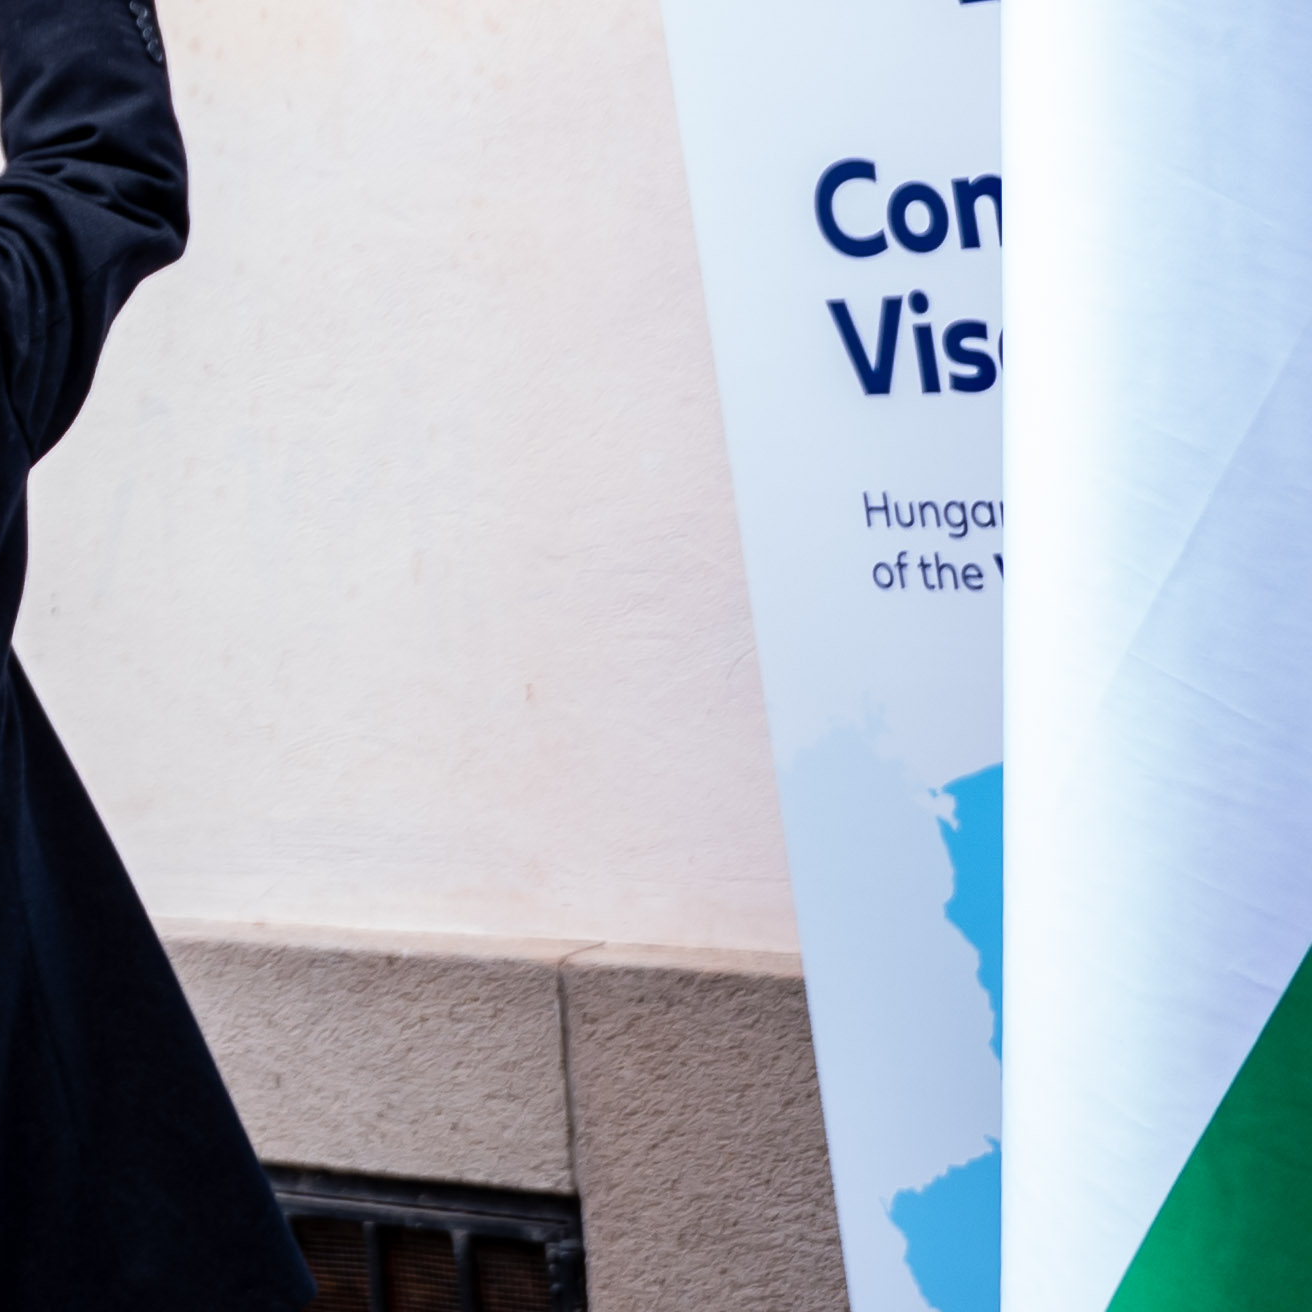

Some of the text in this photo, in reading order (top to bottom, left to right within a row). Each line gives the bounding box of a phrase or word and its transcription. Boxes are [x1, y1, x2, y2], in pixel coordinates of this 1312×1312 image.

[825, 289, 1003, 396] Vis
[863, 491, 1003, 539] Hunga
[872, 550, 908, 589] of
[917, 551, 984, 590] the
